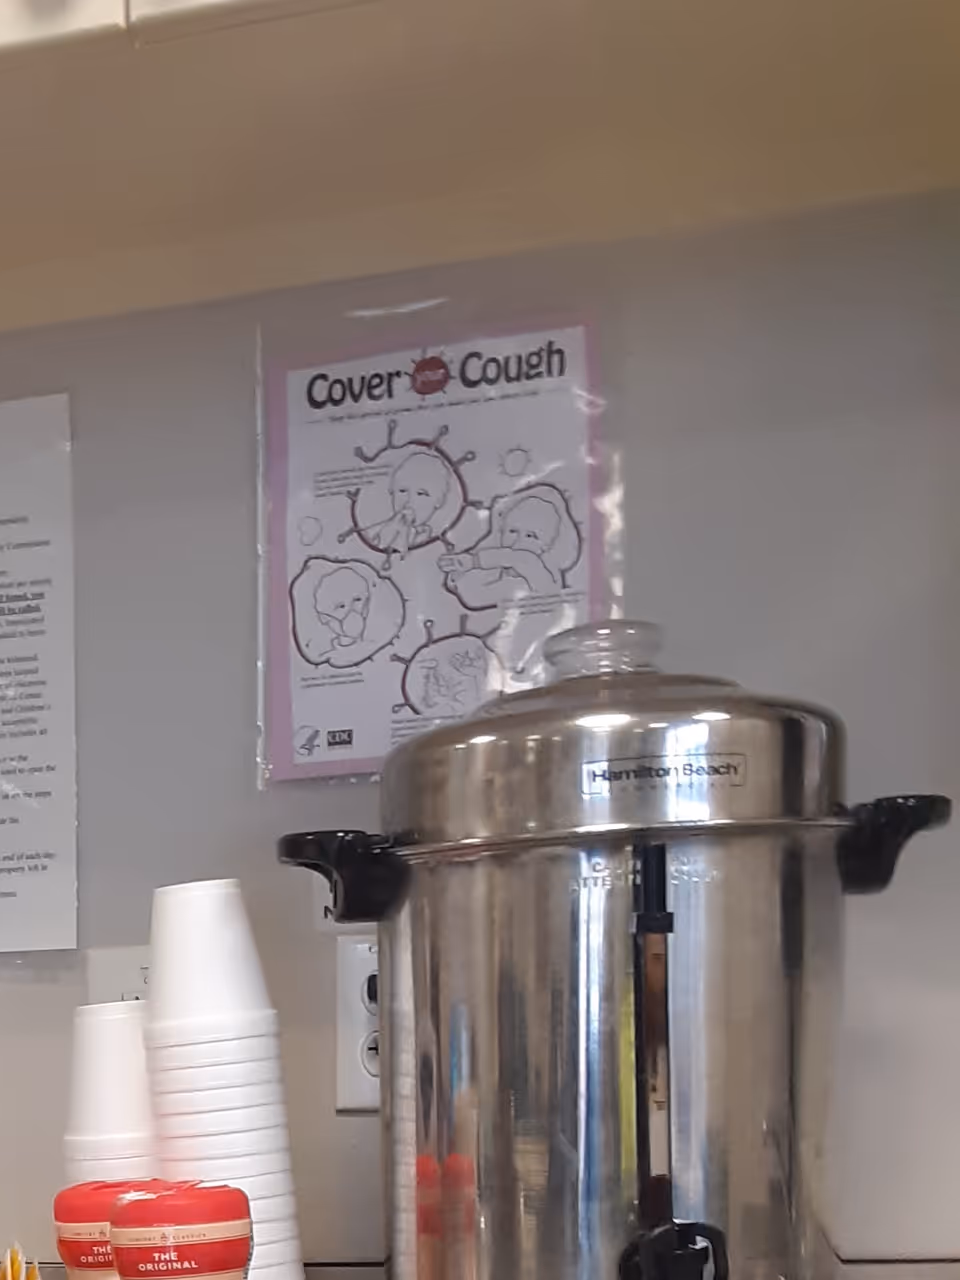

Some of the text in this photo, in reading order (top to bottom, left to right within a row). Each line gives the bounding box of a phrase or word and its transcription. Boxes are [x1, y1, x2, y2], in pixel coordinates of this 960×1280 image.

[306, 369, 402, 410] Cover
[459, 340, 565, 389] Cough
[682, 762, 739, 777] Beach
[152, 1252, 178, 1262] THE
[138, 1260, 199, 1272] ORIGINAL
